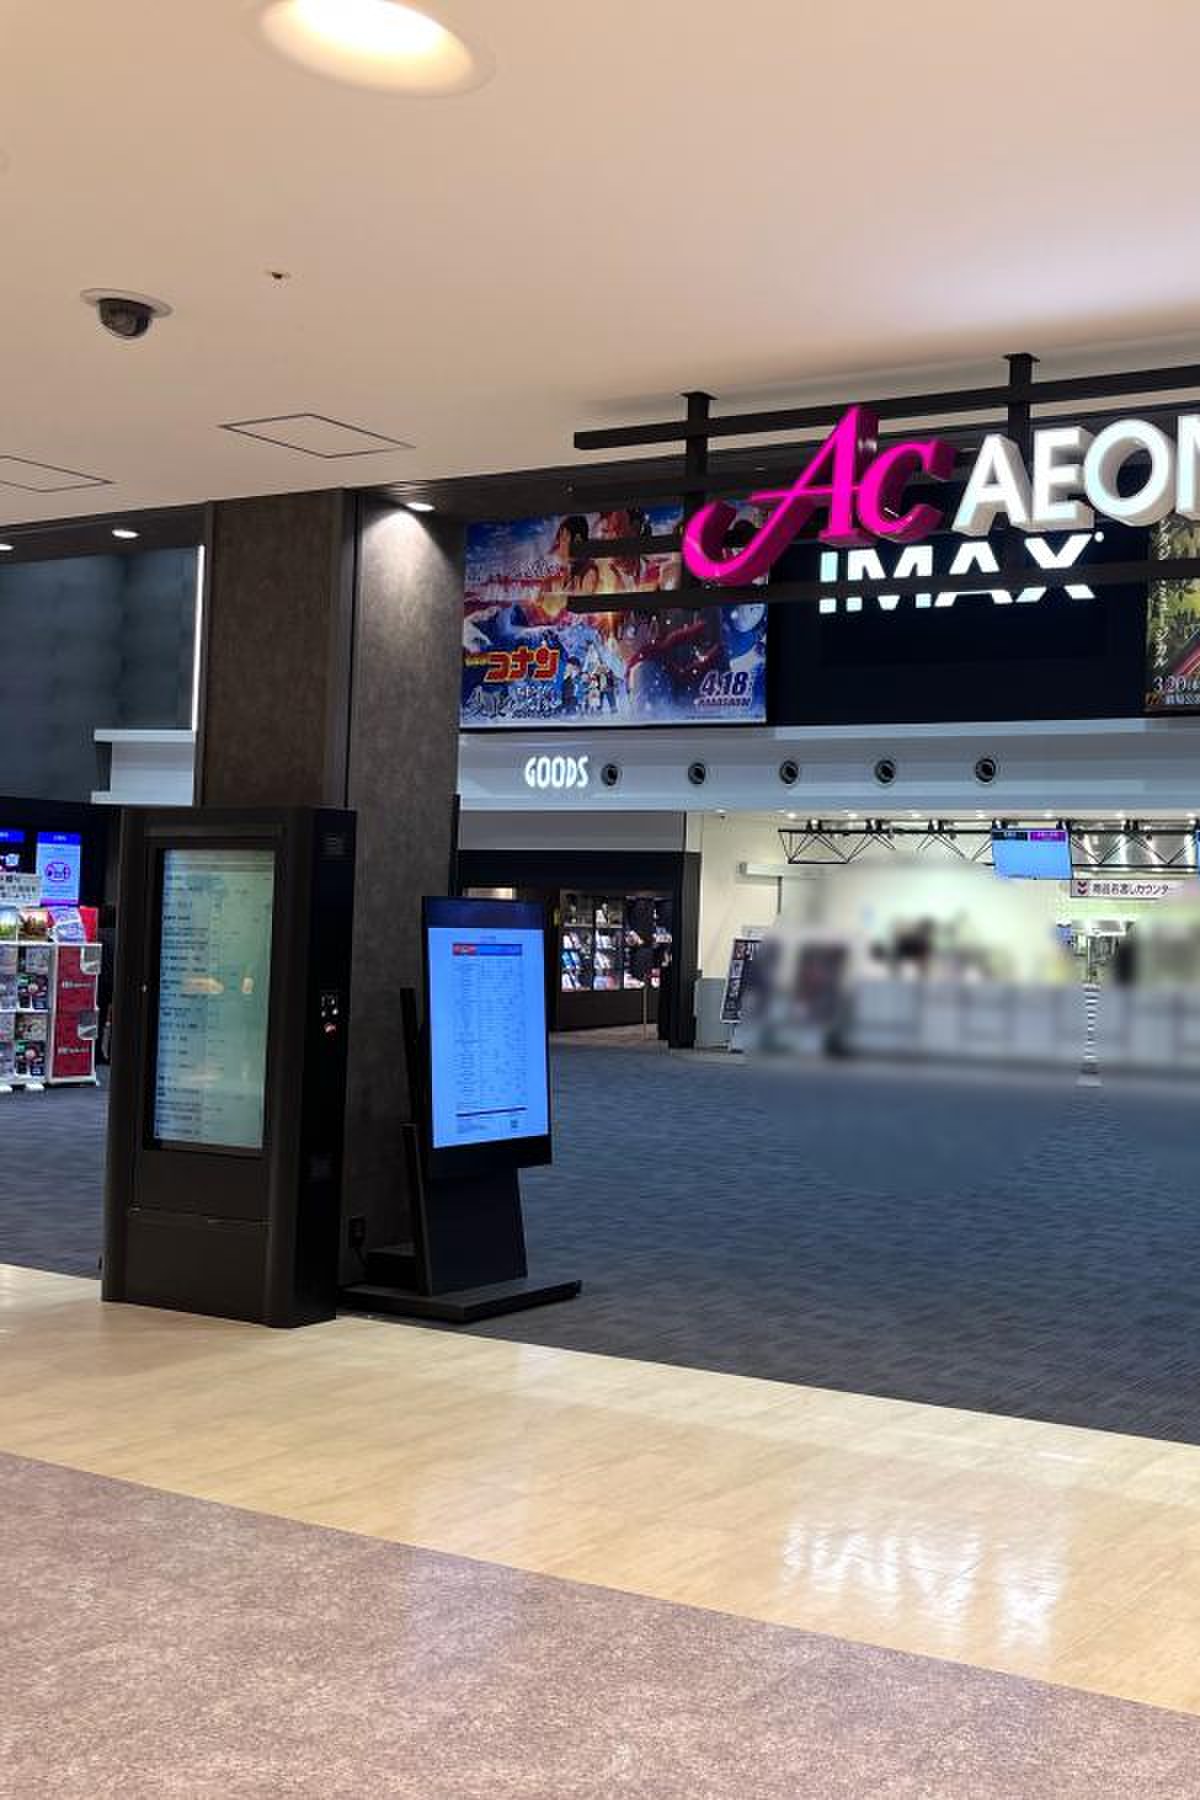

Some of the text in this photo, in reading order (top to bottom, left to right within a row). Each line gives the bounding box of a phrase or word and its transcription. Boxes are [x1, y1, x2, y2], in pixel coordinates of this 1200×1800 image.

[819, 534, 1095, 613] IMAX
[484, 646, 559, 682] コナン
[524, 755, 589, 788] GOODS
